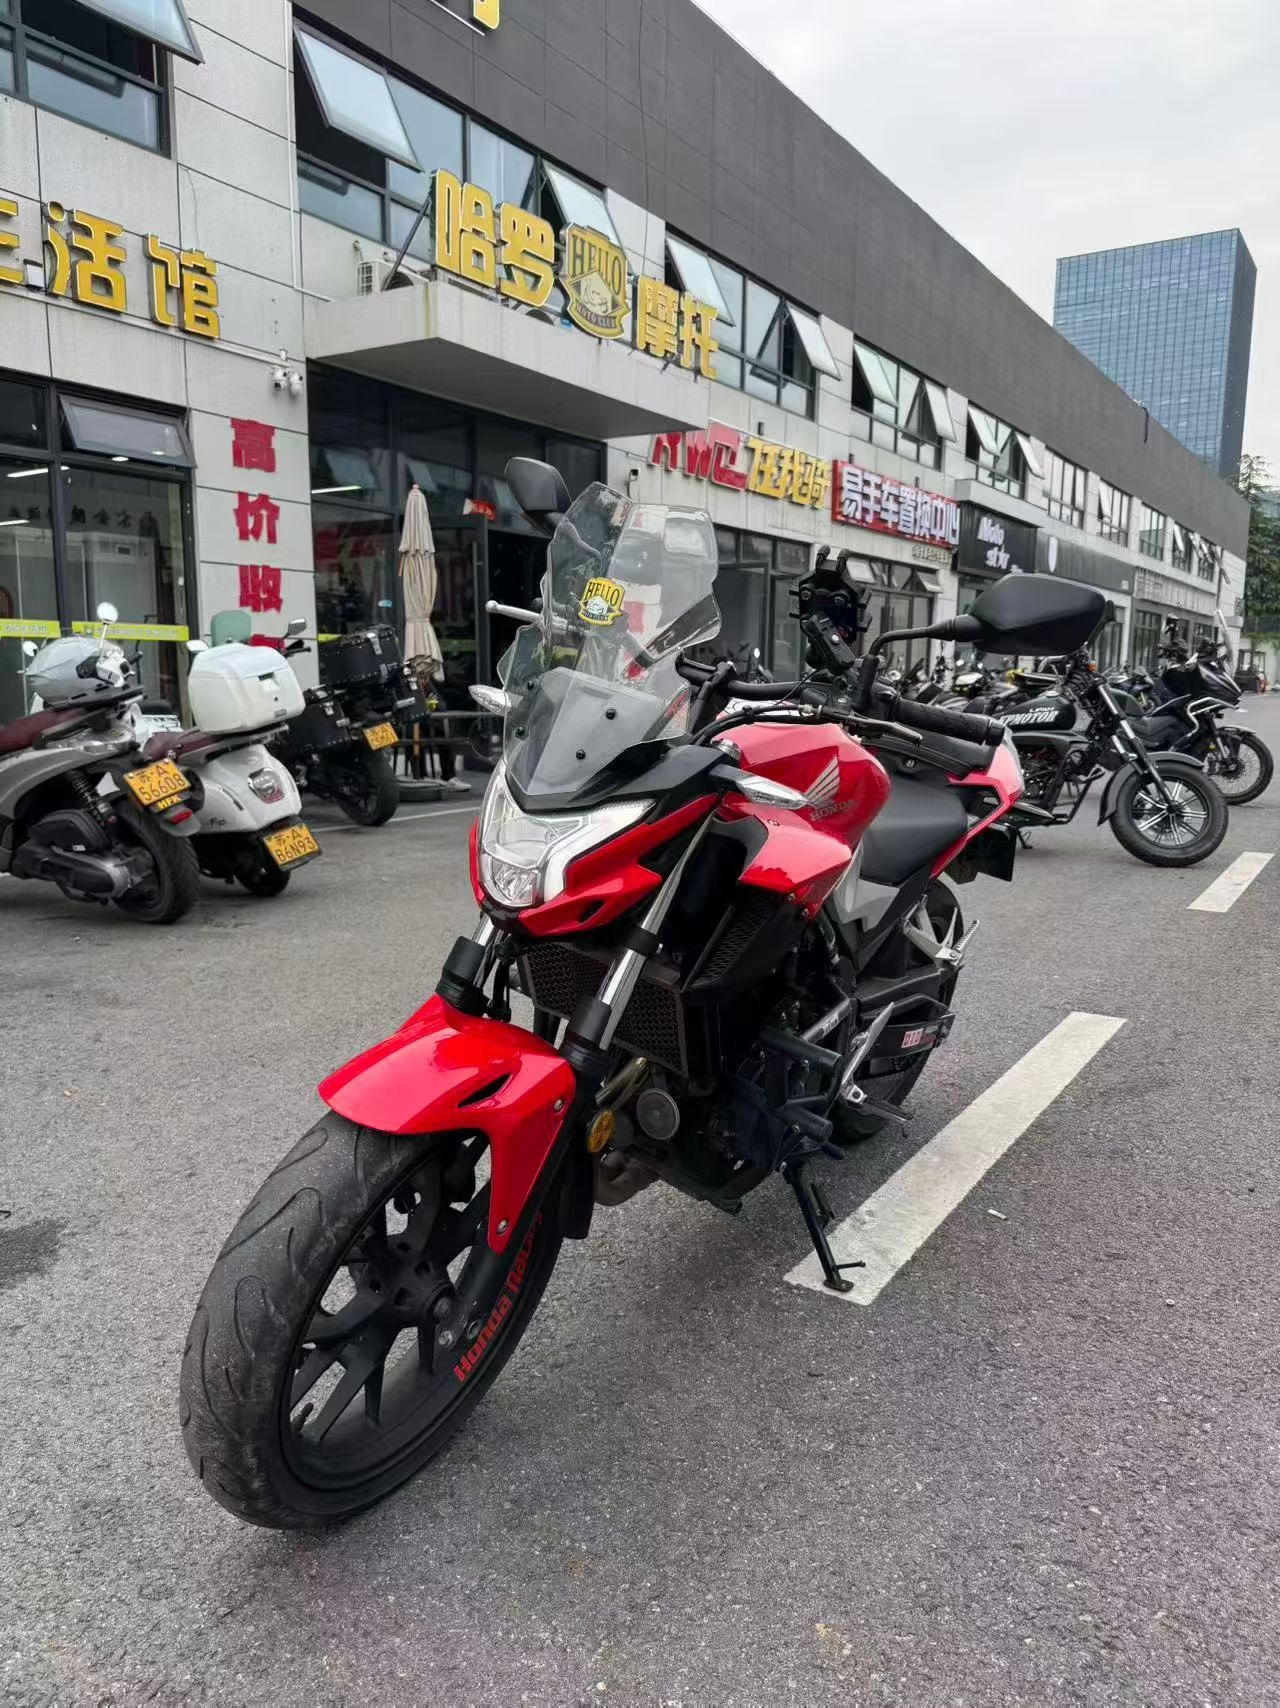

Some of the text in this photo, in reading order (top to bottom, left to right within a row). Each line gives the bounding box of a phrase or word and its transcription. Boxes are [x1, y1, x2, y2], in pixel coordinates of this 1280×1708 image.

[434, 169, 719, 379] 哈罗 摩托
[571, 234, 622, 296] HELLO
[745, 435, 832, 509] 任我骑
[842, 464, 960, 545] 易手车置换中心
[230, 417, 285, 649] 高价收
[585, 581, 620, 607] HELLO
[138, 773, 187, 801] 56608
[811, 800, 857, 822] HONDA
[275, 837, 316, 862] B6N93
[453, 1295, 513, 1382] Honda
